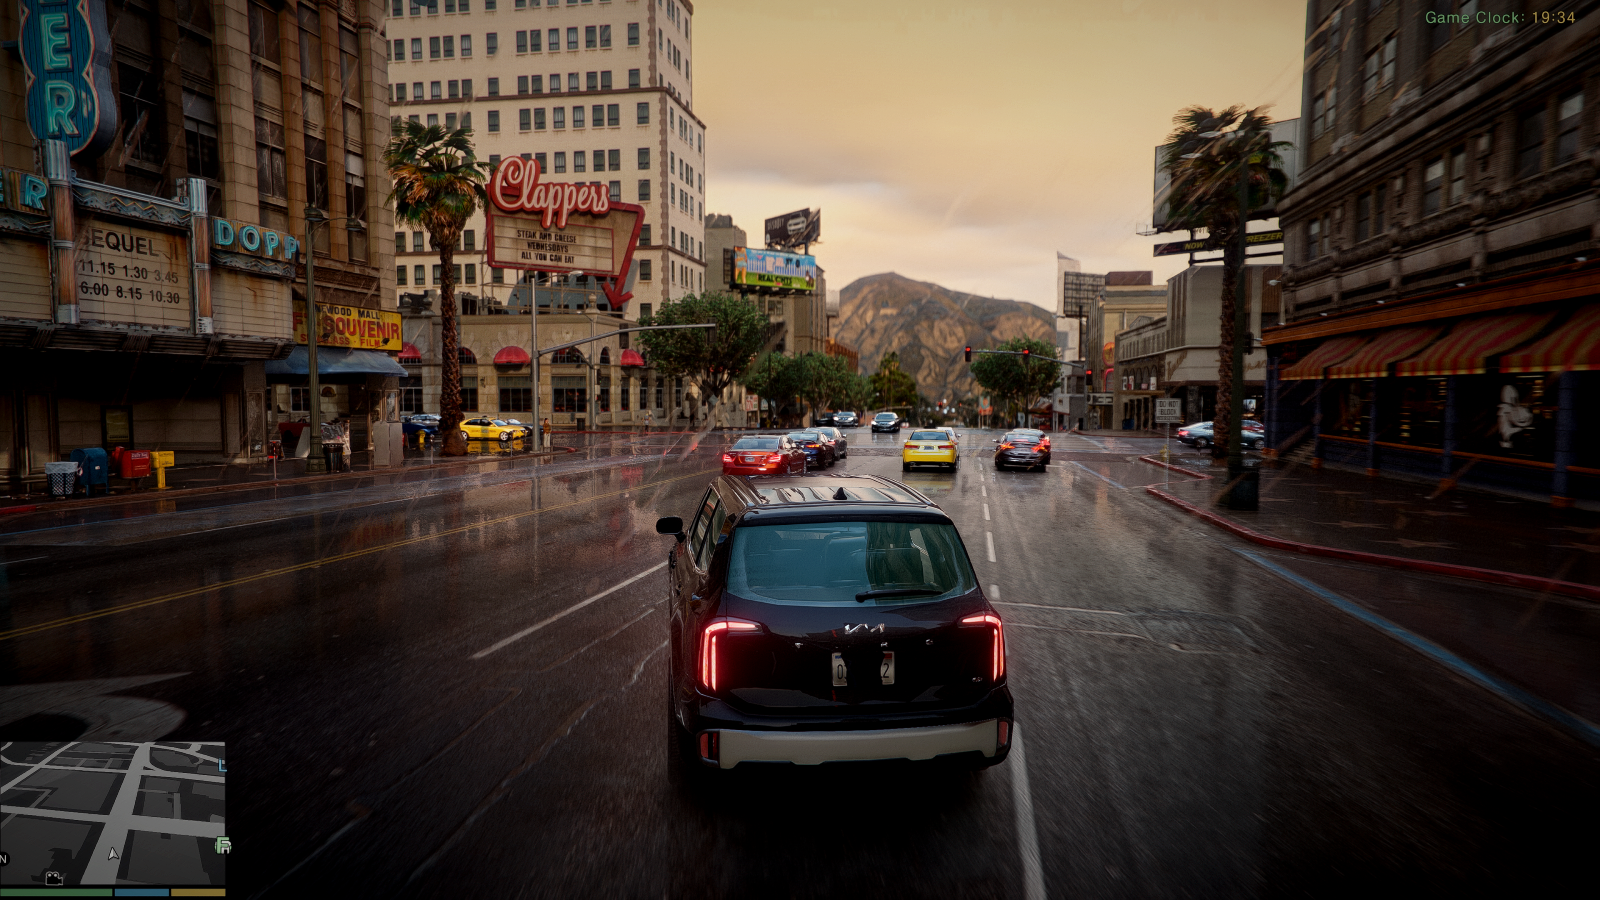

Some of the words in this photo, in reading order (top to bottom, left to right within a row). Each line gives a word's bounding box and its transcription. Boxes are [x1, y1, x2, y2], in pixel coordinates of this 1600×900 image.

[41, 0, 80, 138] ER
[494, 155, 610, 228] Clappers
[213, 219, 300, 261] DOPP
[517, 229, 537, 239] STEAK
[539, 231, 552, 241] AND
[554, 233, 577, 243] CHEESE
[1184, 241, 1205, 250] NOW
[1245, 232, 1283, 243] REEZER
[527, 241, 569, 253] WEDNESDAYS
[521, 251, 531, 260] ALL
[535, 252, 547, 261] YOU
[549, 253, 562, 263] CAN
[564, 255, 574, 264] EAT
[80, 258, 115, 275] 11.15
[123, 264, 148, 280] 1.30
[154, 269, 178, 284] 3.45
[80, 281, 109, 297] 6.00
[116, 285, 142, 300] 8.15
[149, 289, 180, 304] 10.30
[315, 304, 352, 317] NEWOOD
[358, 310, 380, 320] MALL
[322, 315, 400, 340] SOUVENIR
[360, 338, 381, 347] FILM
